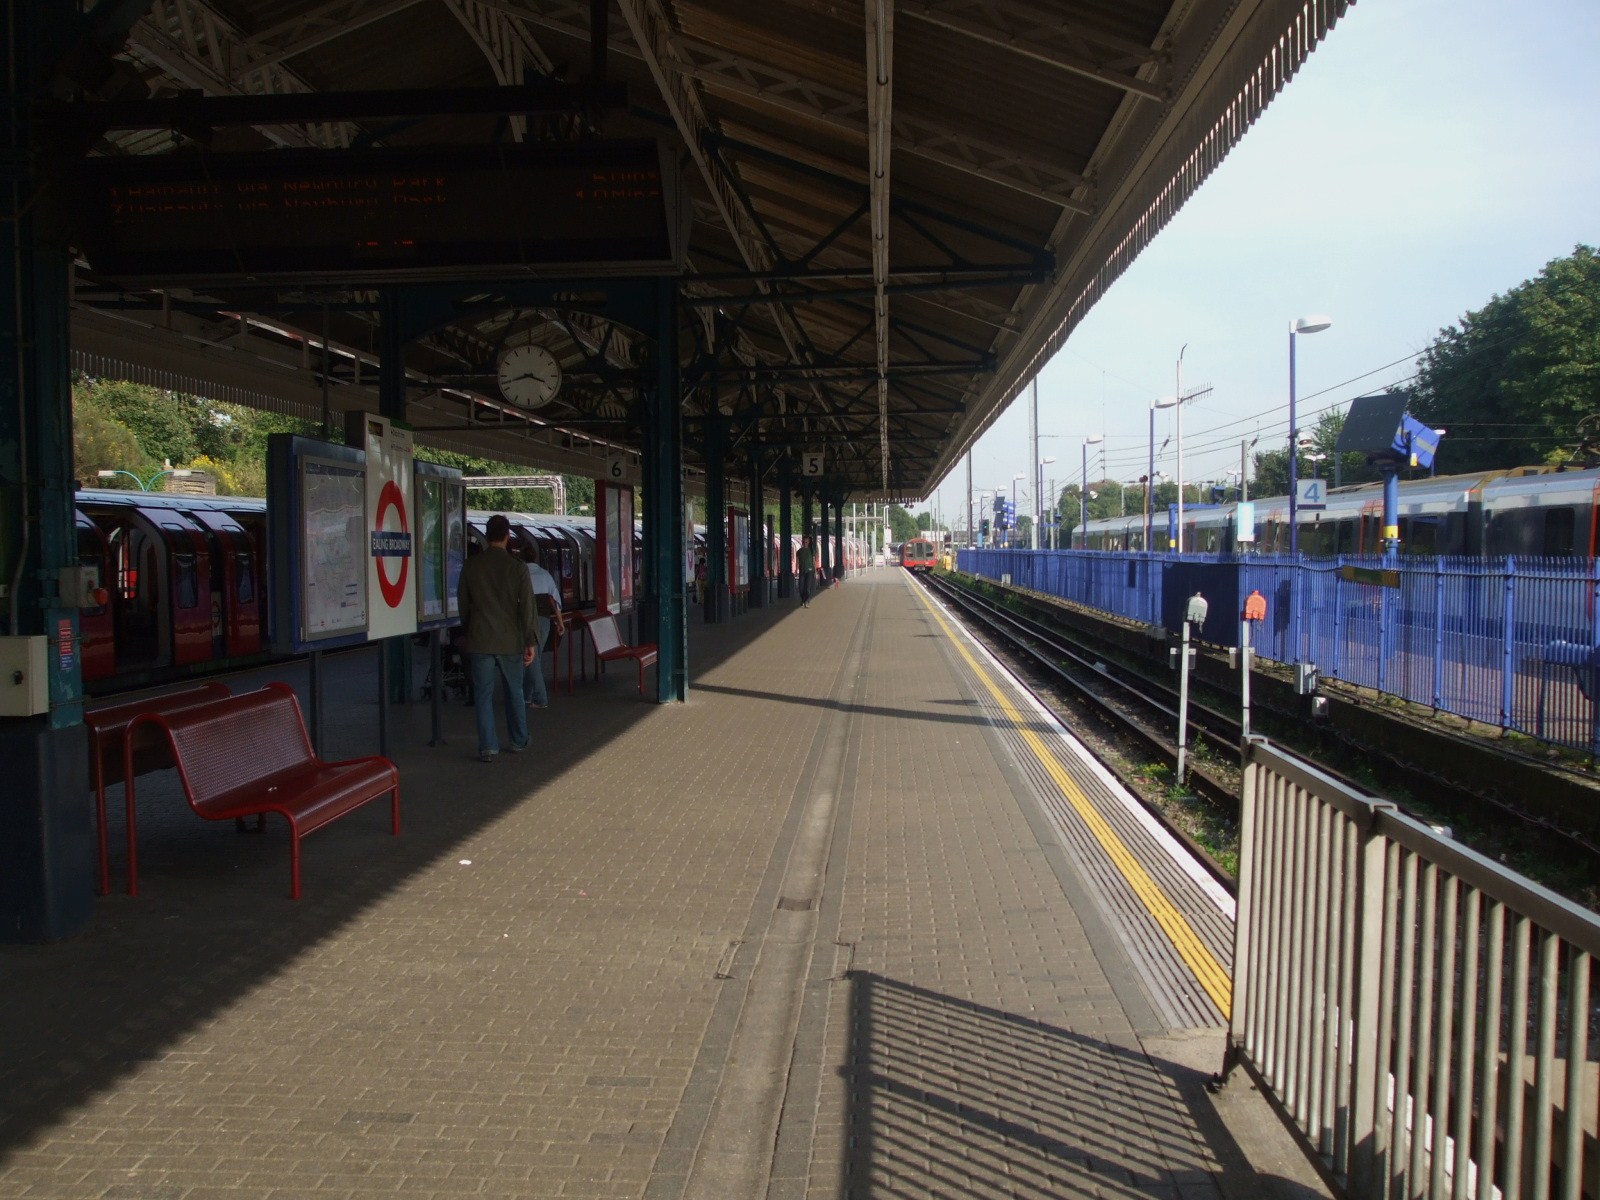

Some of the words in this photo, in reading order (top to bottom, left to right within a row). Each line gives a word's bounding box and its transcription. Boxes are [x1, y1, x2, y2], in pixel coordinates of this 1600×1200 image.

[611, 461, 622, 477] 6
[808, 457, 819, 474] 5
[1303, 482, 1320, 503] 4
[372, 538, 388, 550] EALING
[389, 538, 411, 551] BROADWAY
